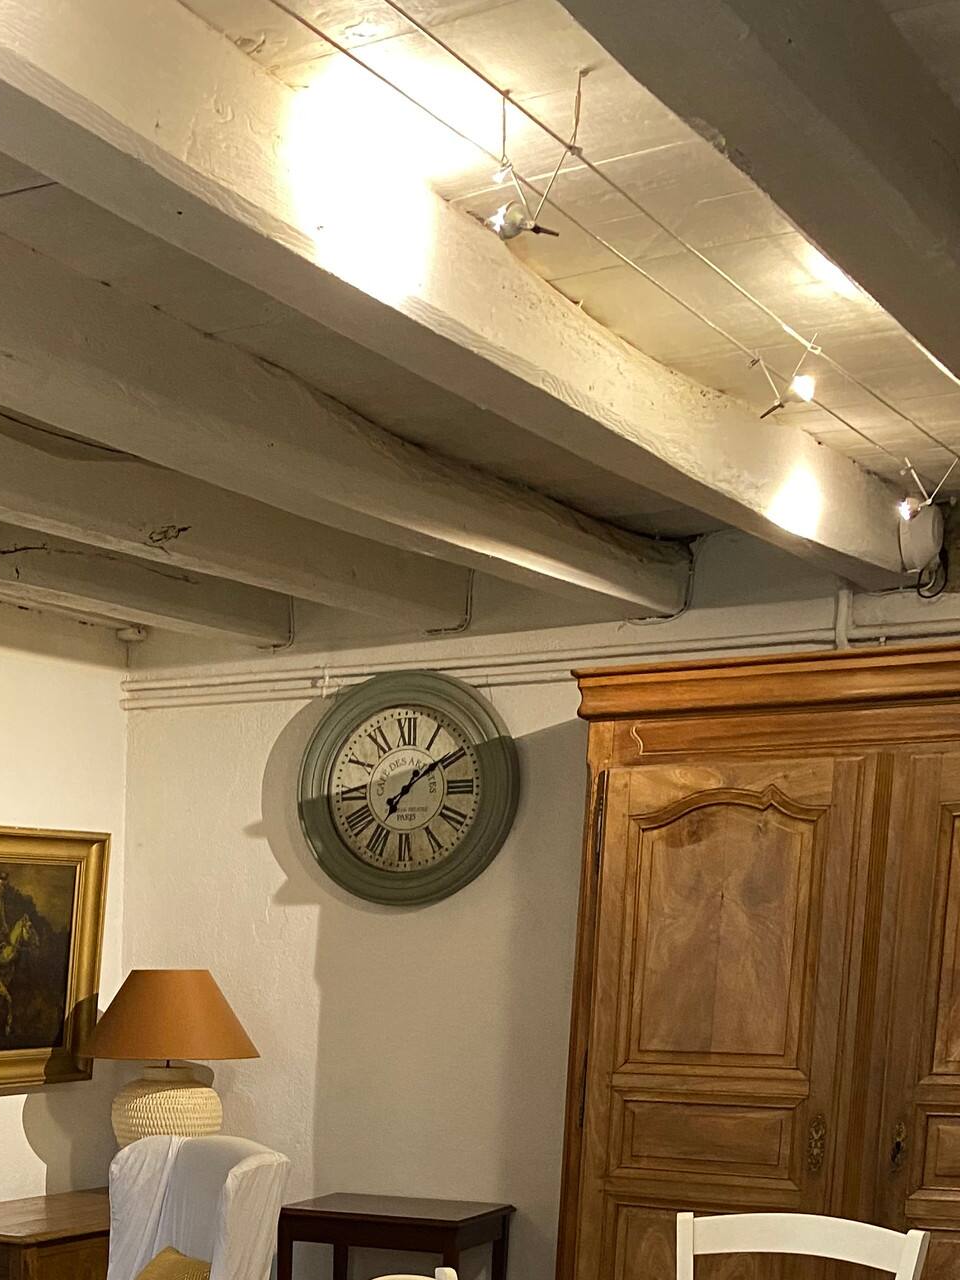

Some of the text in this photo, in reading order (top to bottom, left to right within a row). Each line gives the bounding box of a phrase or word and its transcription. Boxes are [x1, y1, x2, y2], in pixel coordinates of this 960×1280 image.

[367, 725, 393, 759] XI
[397, 717, 417, 747] XII
[426, 724, 442, 750] I
[348, 752, 375, 775] X
[442, 746, 468, 769] II
[341, 784, 367, 802] IX
[446, 778, 474, 795] III
[346, 805, 375, 837] VIII
[439, 805, 467, 831] IV
[366, 824, 390, 857] VII
[397, 833, 413, 861] VI
[425, 827, 444, 854] V
